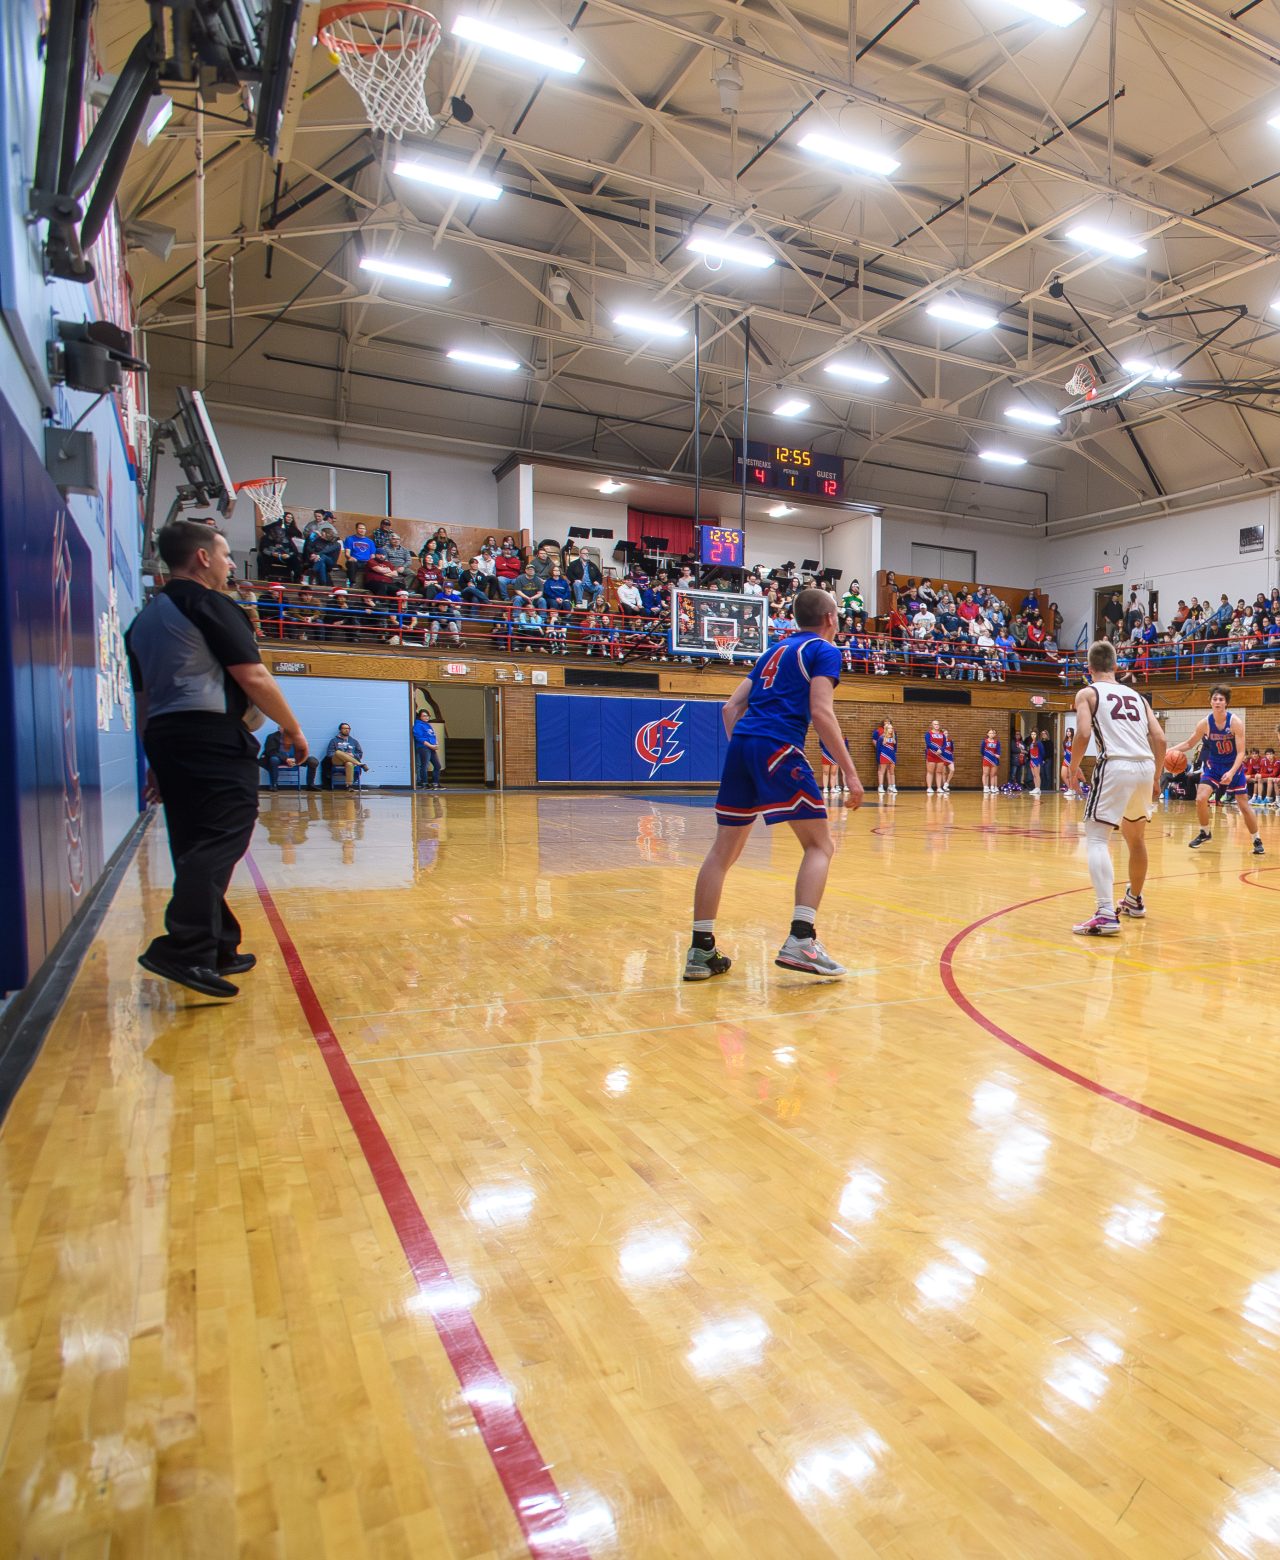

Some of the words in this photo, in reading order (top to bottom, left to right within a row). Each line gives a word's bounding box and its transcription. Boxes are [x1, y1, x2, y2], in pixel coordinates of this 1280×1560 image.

[776, 447, 811, 466] 12:55
[755, 469, 765, 483] 4
[791, 476, 795, 487] 1
[816, 470, 837, 480] GUEST
[823, 480, 837, 496] 12
[710, 530, 739, 544] 12:55
[711, 541, 735, 562] 27
[760, 644, 790, 690] 4
[1106, 693, 1141, 722] 25
[1216, 740, 1233, 755] 10
